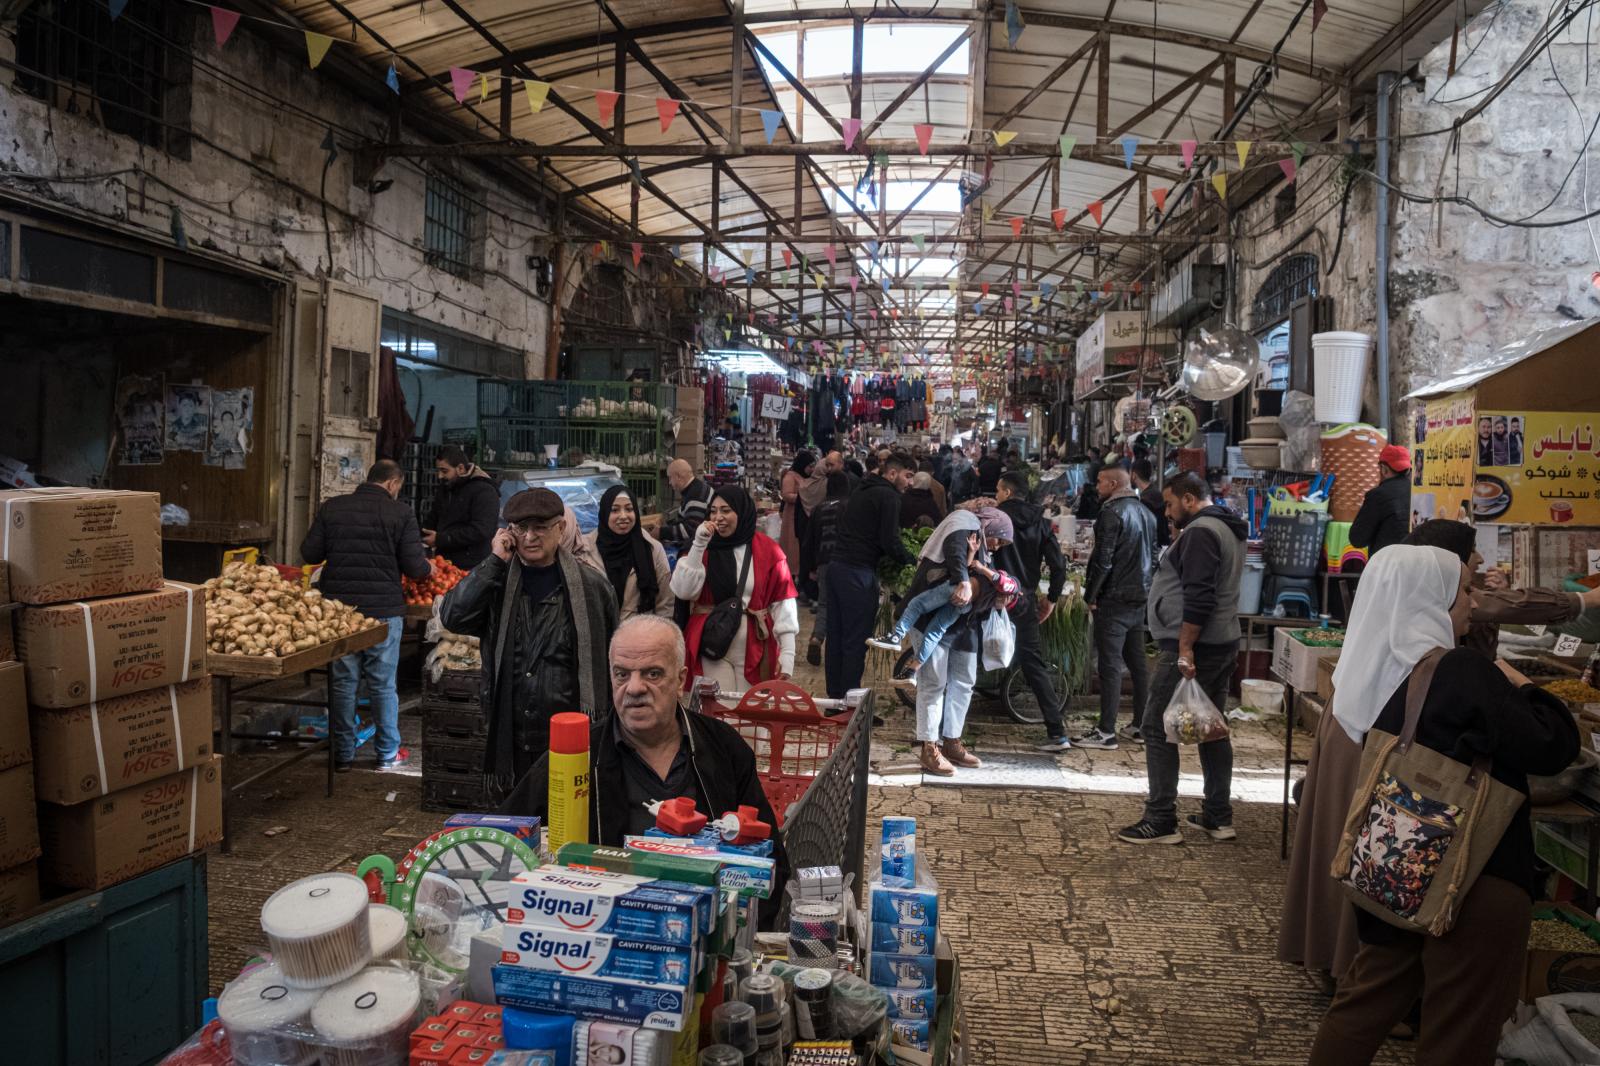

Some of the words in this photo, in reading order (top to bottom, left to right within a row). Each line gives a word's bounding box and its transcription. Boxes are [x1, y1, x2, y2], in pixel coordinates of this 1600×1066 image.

[1533, 424, 1593, 461] نابلس
[1525, 465, 1571, 480] شوكو
[1539, 487, 1590, 499] سحلب
[593, 848, 632, 858] MAN
[633, 841, 704, 855] Colgate
[543, 875, 602, 889] Signal
[725, 870, 749, 882] Triple
[522, 889, 594, 917] Signal
[620, 900, 646, 909] CAVITY
[647, 902, 678, 913] FIGHTER
[517, 931, 591, 958] Signal
[618, 940, 644, 950] CAVITY
[645, 942, 676, 953] FIGHTER
[650, 1017, 676, 1028] Signal
